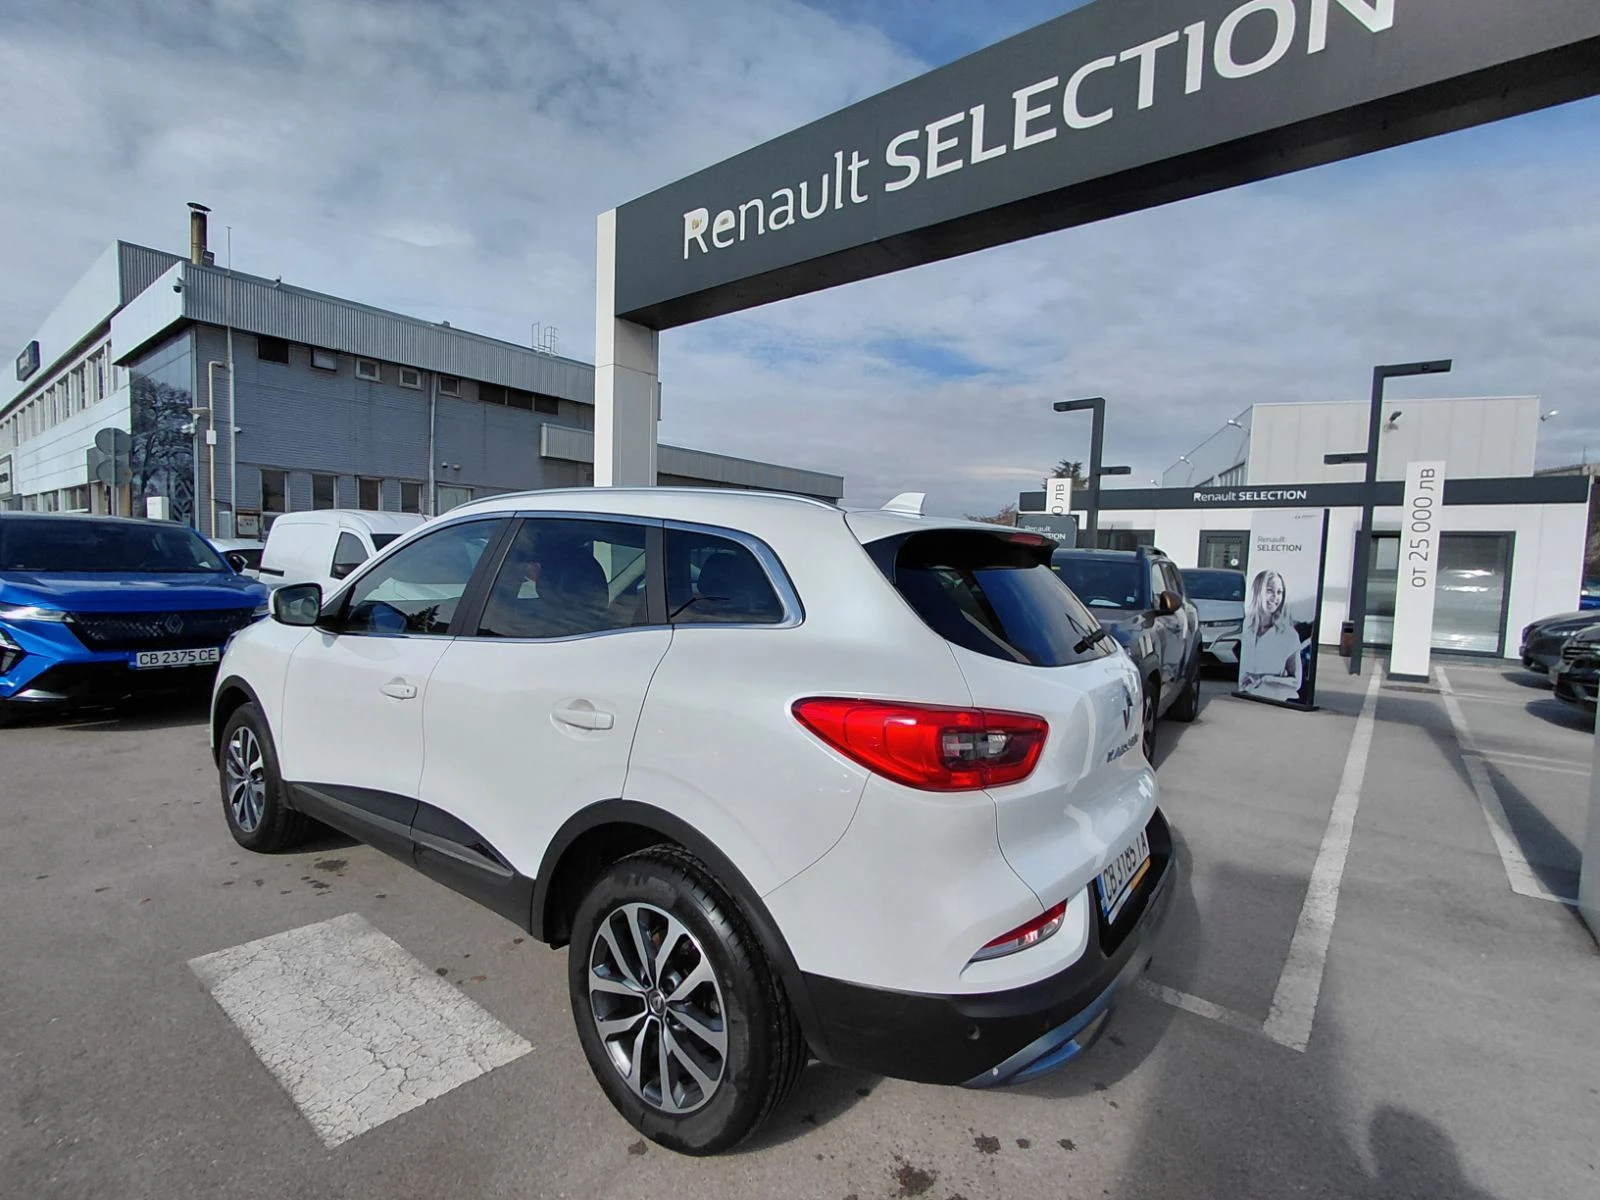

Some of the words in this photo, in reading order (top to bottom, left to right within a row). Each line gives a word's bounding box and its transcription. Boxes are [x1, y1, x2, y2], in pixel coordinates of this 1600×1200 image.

[683, 150, 870, 260] Renault
[884, 0, 1395, 192] SELECTION
[1193, 491, 1237, 502] Renault
[1238, 490, 1307, 501] SELECTION
[1411, 496, 1433, 533] 000
[1257, 544, 1302, 552] SELECTION
[1408, 538, 1430, 561] 25
[139, 653, 159, 665] CB
[162, 650, 197, 664] 2375
[198, 649, 217, 661] CE
